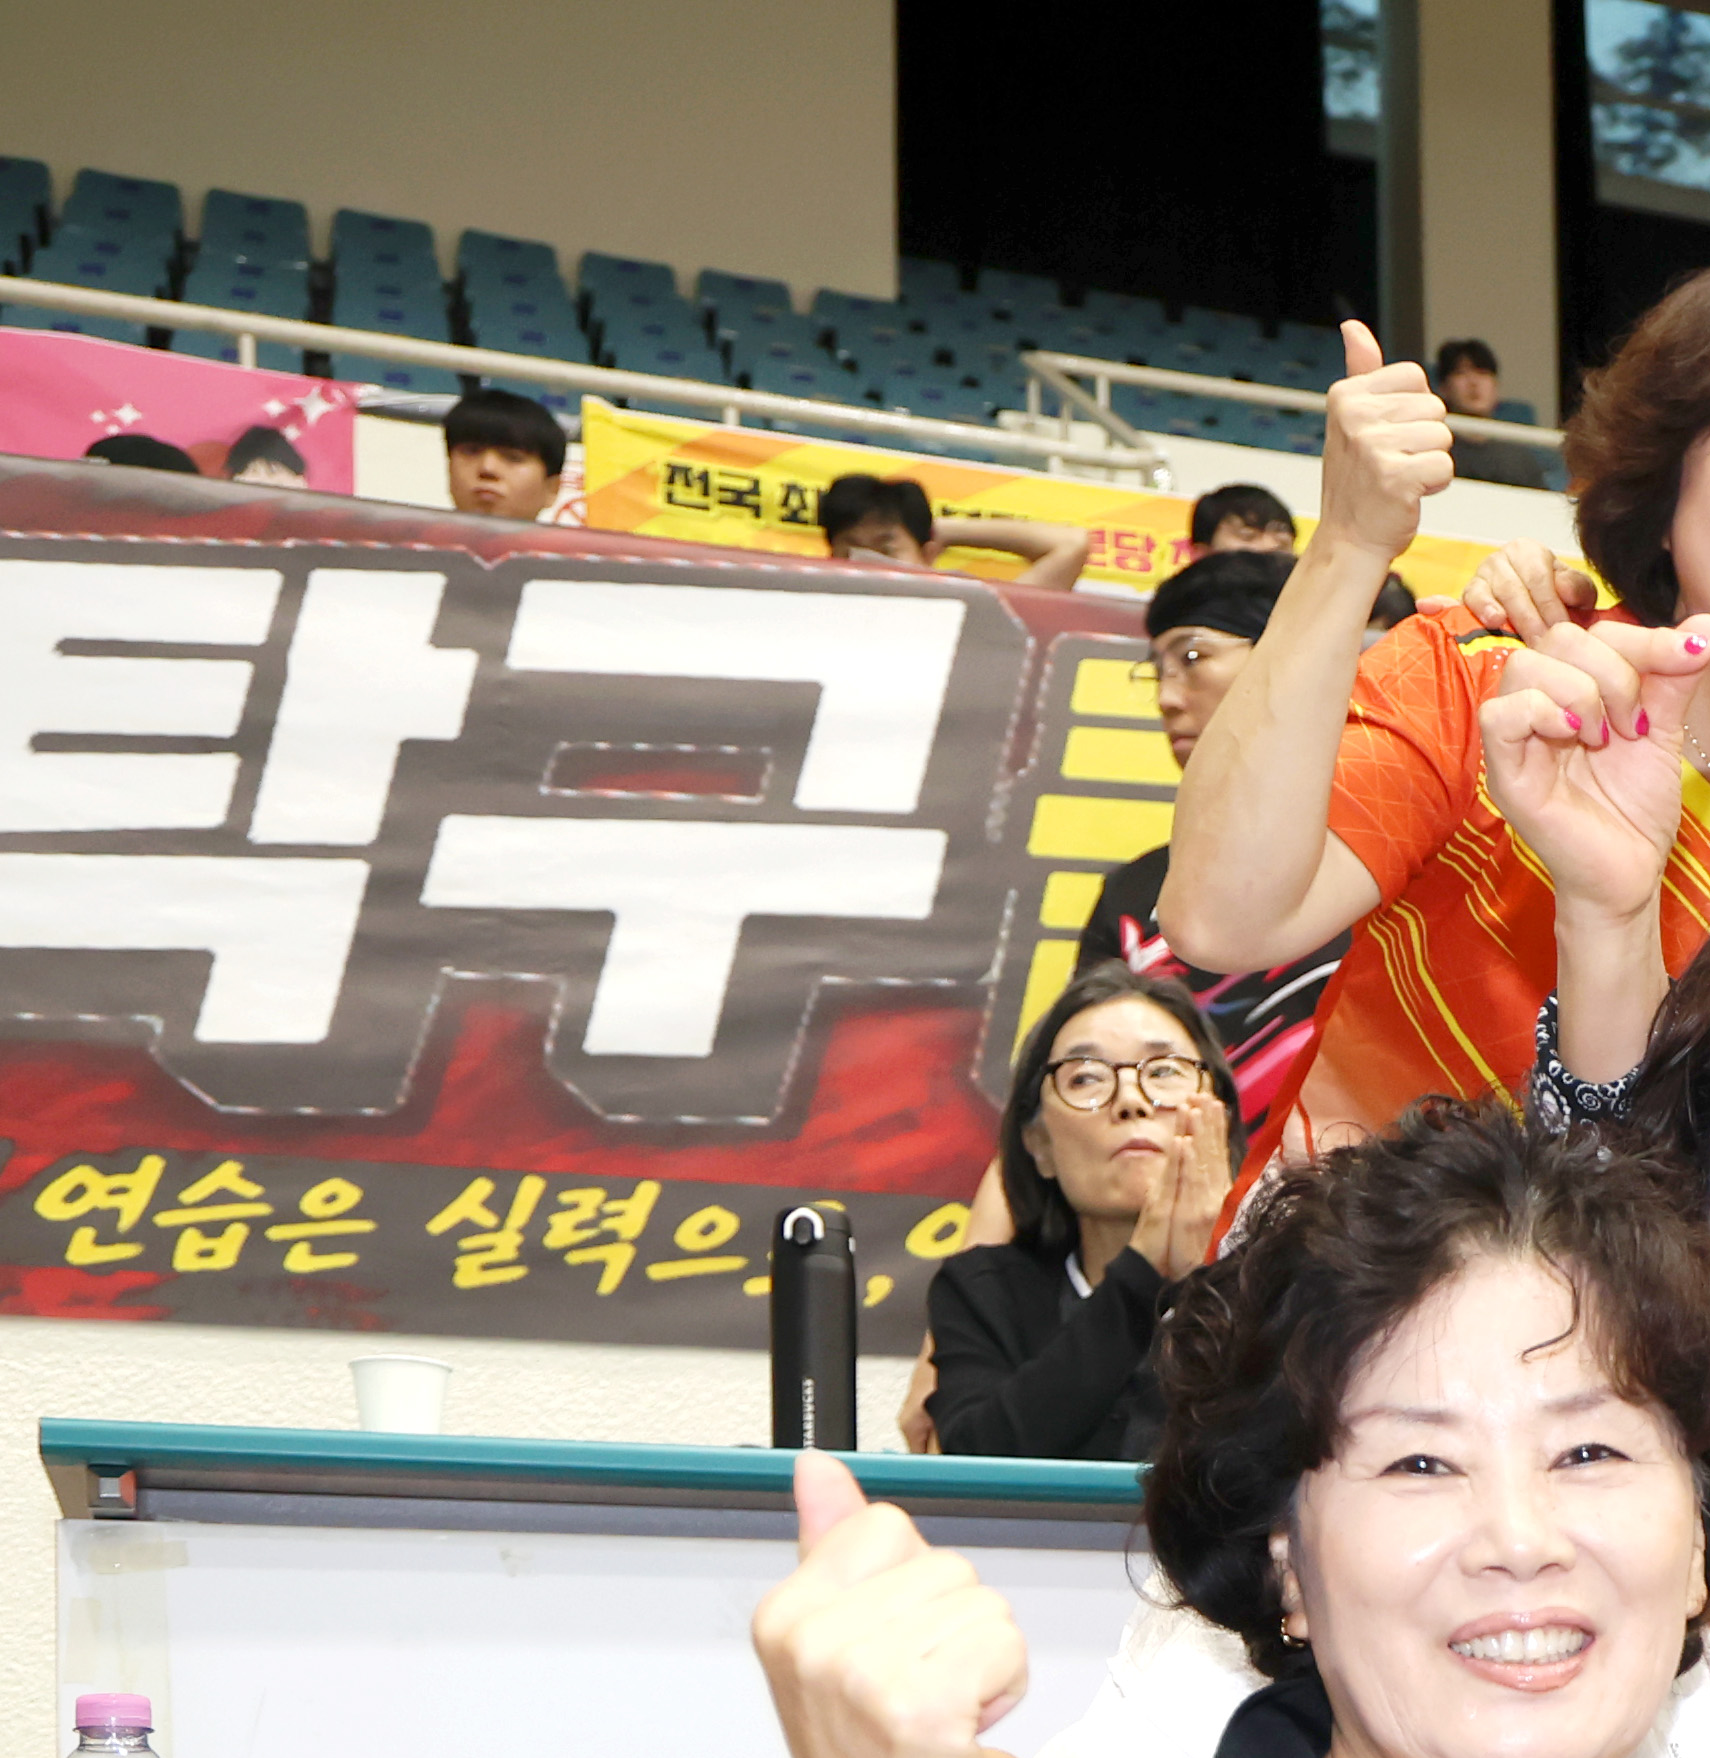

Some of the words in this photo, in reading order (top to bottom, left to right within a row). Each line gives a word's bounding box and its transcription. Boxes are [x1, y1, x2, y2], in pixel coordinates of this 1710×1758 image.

[664, 462, 762, 518] 전국
[780, 482, 821, 527] 최
[0, 558, 966, 1058] 탁구
[33, 1154, 378, 1274] 연습은
[424, 1173, 896, 1307] 실력으,
[801, 1376, 816, 1448] TARBUCKS
